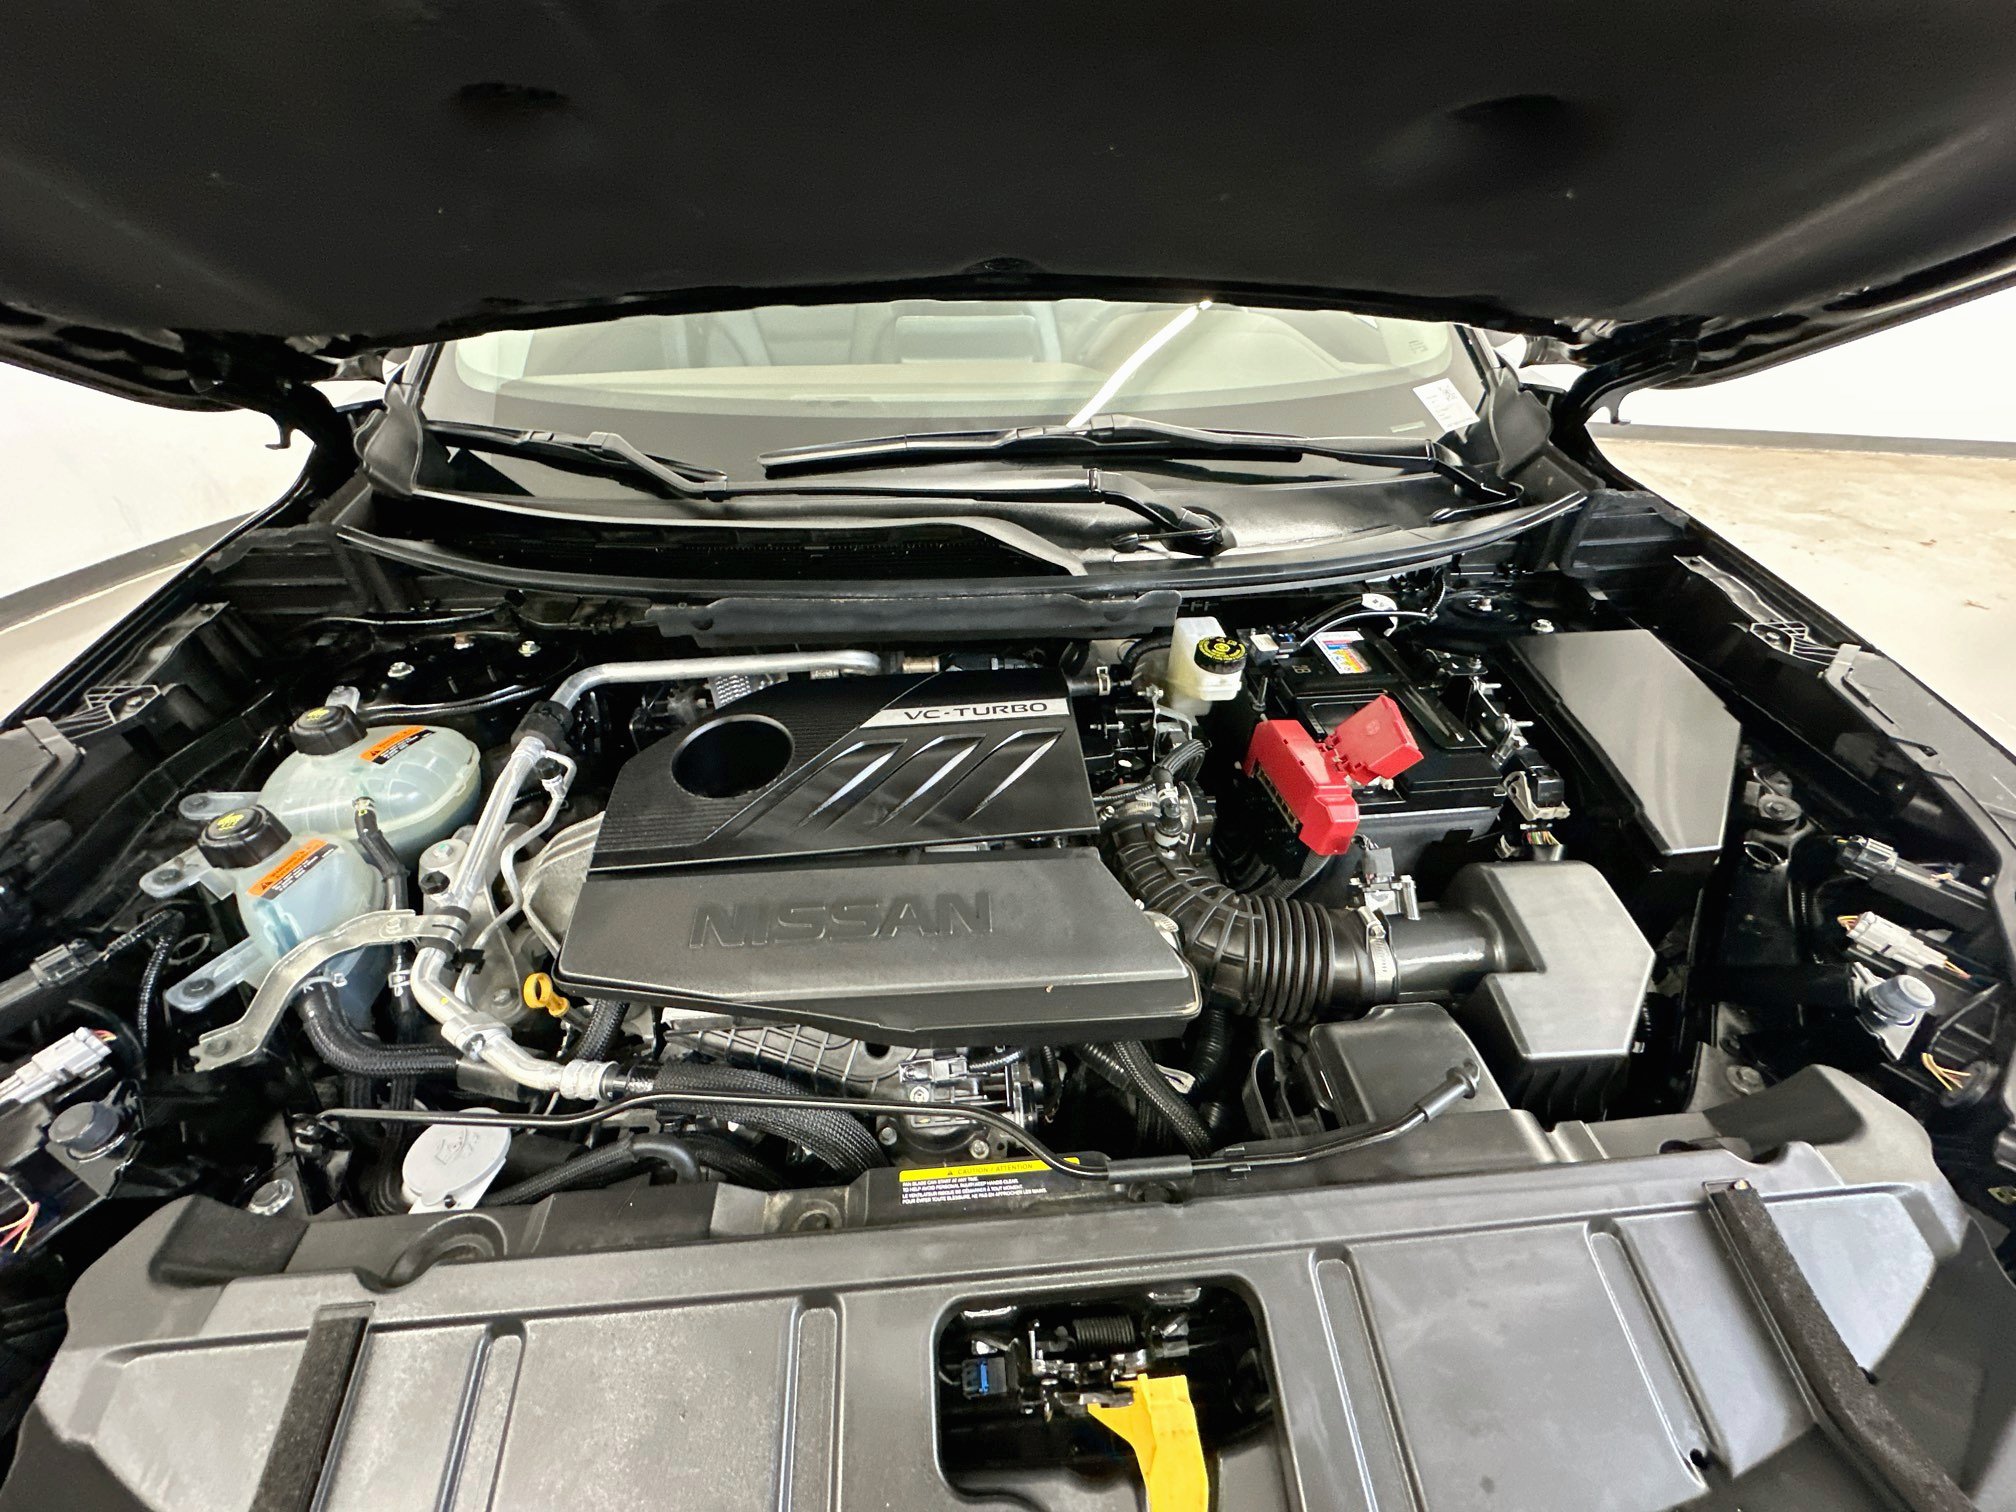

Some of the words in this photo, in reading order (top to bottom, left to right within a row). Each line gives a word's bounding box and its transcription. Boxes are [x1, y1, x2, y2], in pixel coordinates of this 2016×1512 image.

[904, 702, 1048, 720] VC-TURBO
[689, 891, 992, 949] NISSAN
[996, 1163, 1032, 1171] ATTENTION
